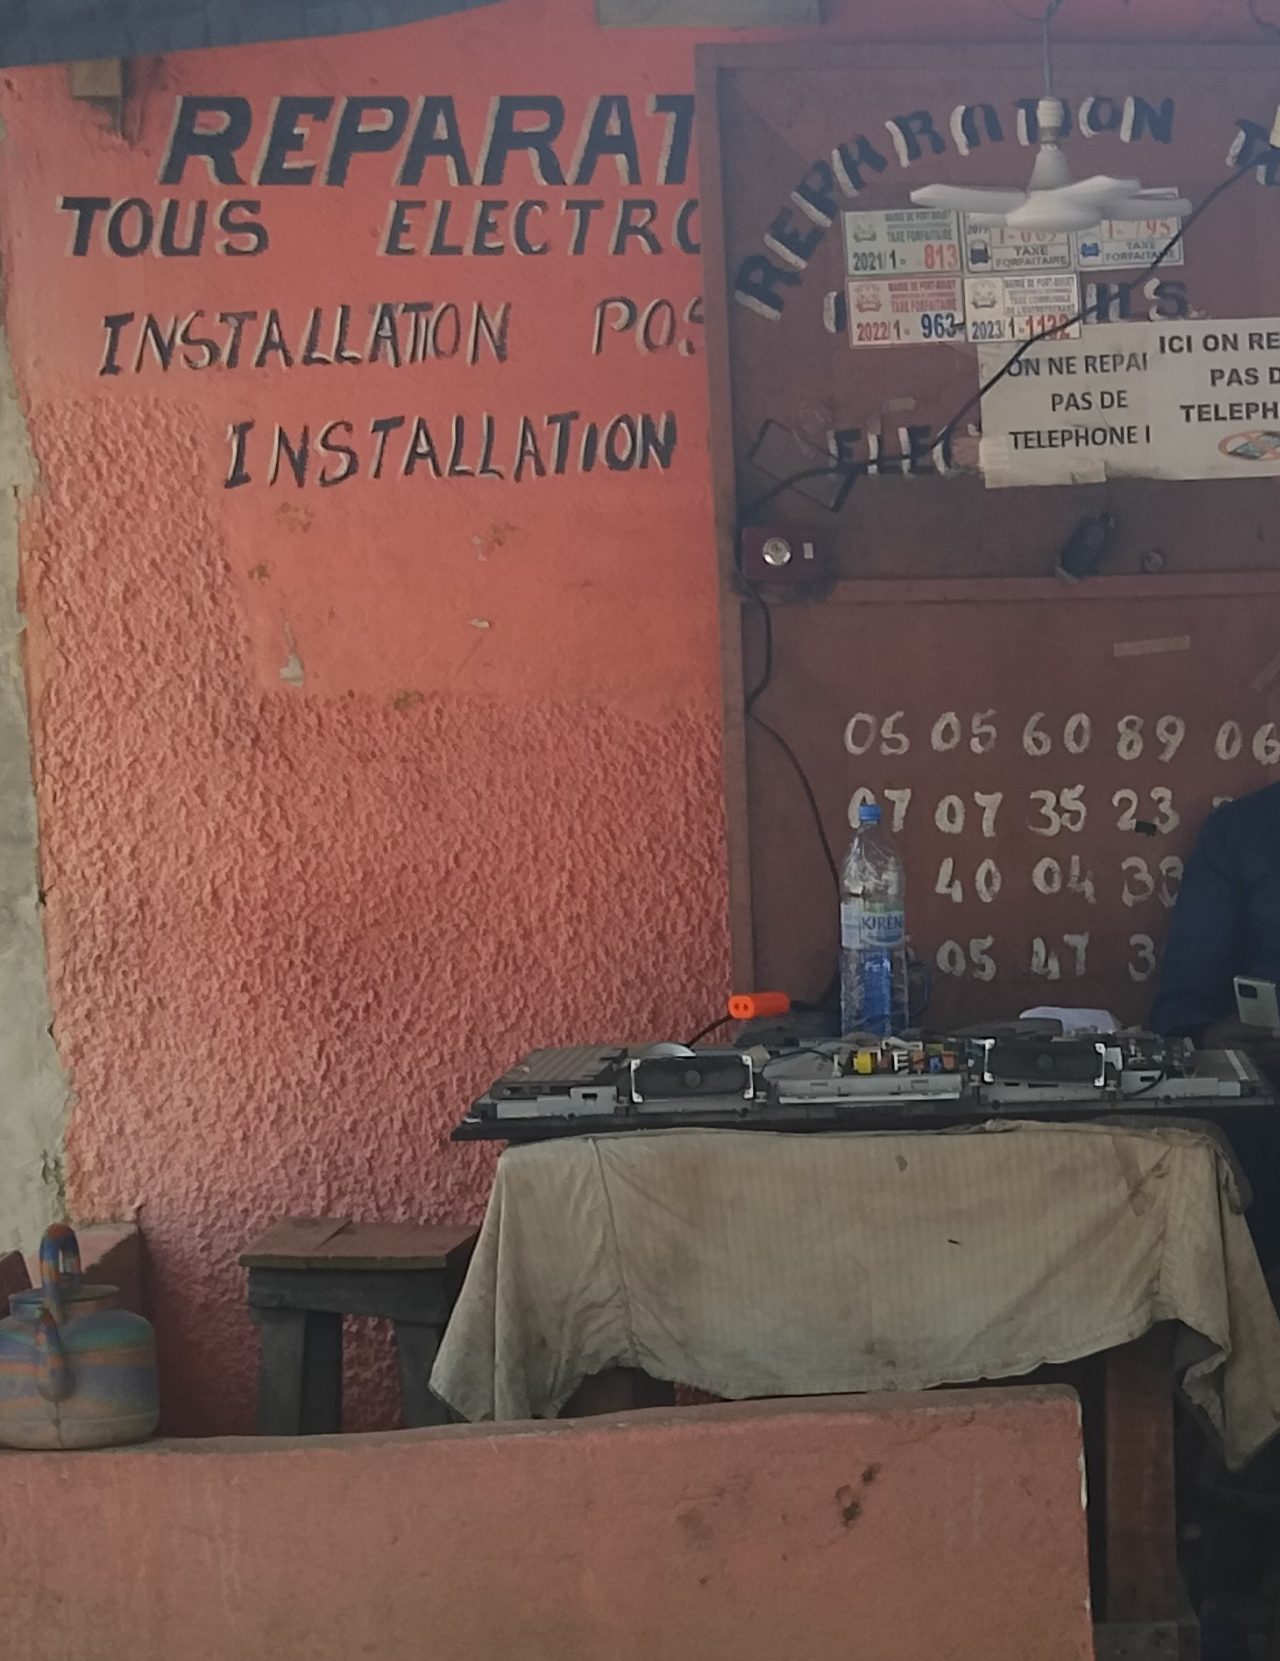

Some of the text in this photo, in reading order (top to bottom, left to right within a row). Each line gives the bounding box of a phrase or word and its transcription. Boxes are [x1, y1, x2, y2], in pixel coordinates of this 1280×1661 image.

[56, 196, 270, 258] TOUS
[1014, 245, 1048, 256] TAXE
[1126, 240, 1156, 250] TAXE
[98, 299, 512, 377] INSTALLATION
[921, 312, 957, 339] 963
[1159, 334, 1193, 354] ICI
[1202, 333, 1239, 353] ON
[1007, 358, 1040, 377] ON
[1049, 356, 1077, 376] NE
[1209, 367, 1259, 388] PAS
[1051, 390, 1128, 412] PAS DE
[222, 409, 679, 489] INSTALLATION
[1009, 425, 1138, 450] TELEPHONE
[844, 711, 910, 757] 05
[930, 708, 998, 755] 05
[1021, 711, 1093, 758] 60
[1116, 713, 1186, 763] 89
[934, 790, 1003, 838] 07
[1027, 784, 1088, 837] 35
[1111, 786, 1181, 835] 23
[933, 856, 1002, 904] 40
[1031, 854, 1096, 905] 04
[936, 934, 998, 982] 05
[1029, 931, 1091, 981] 47
